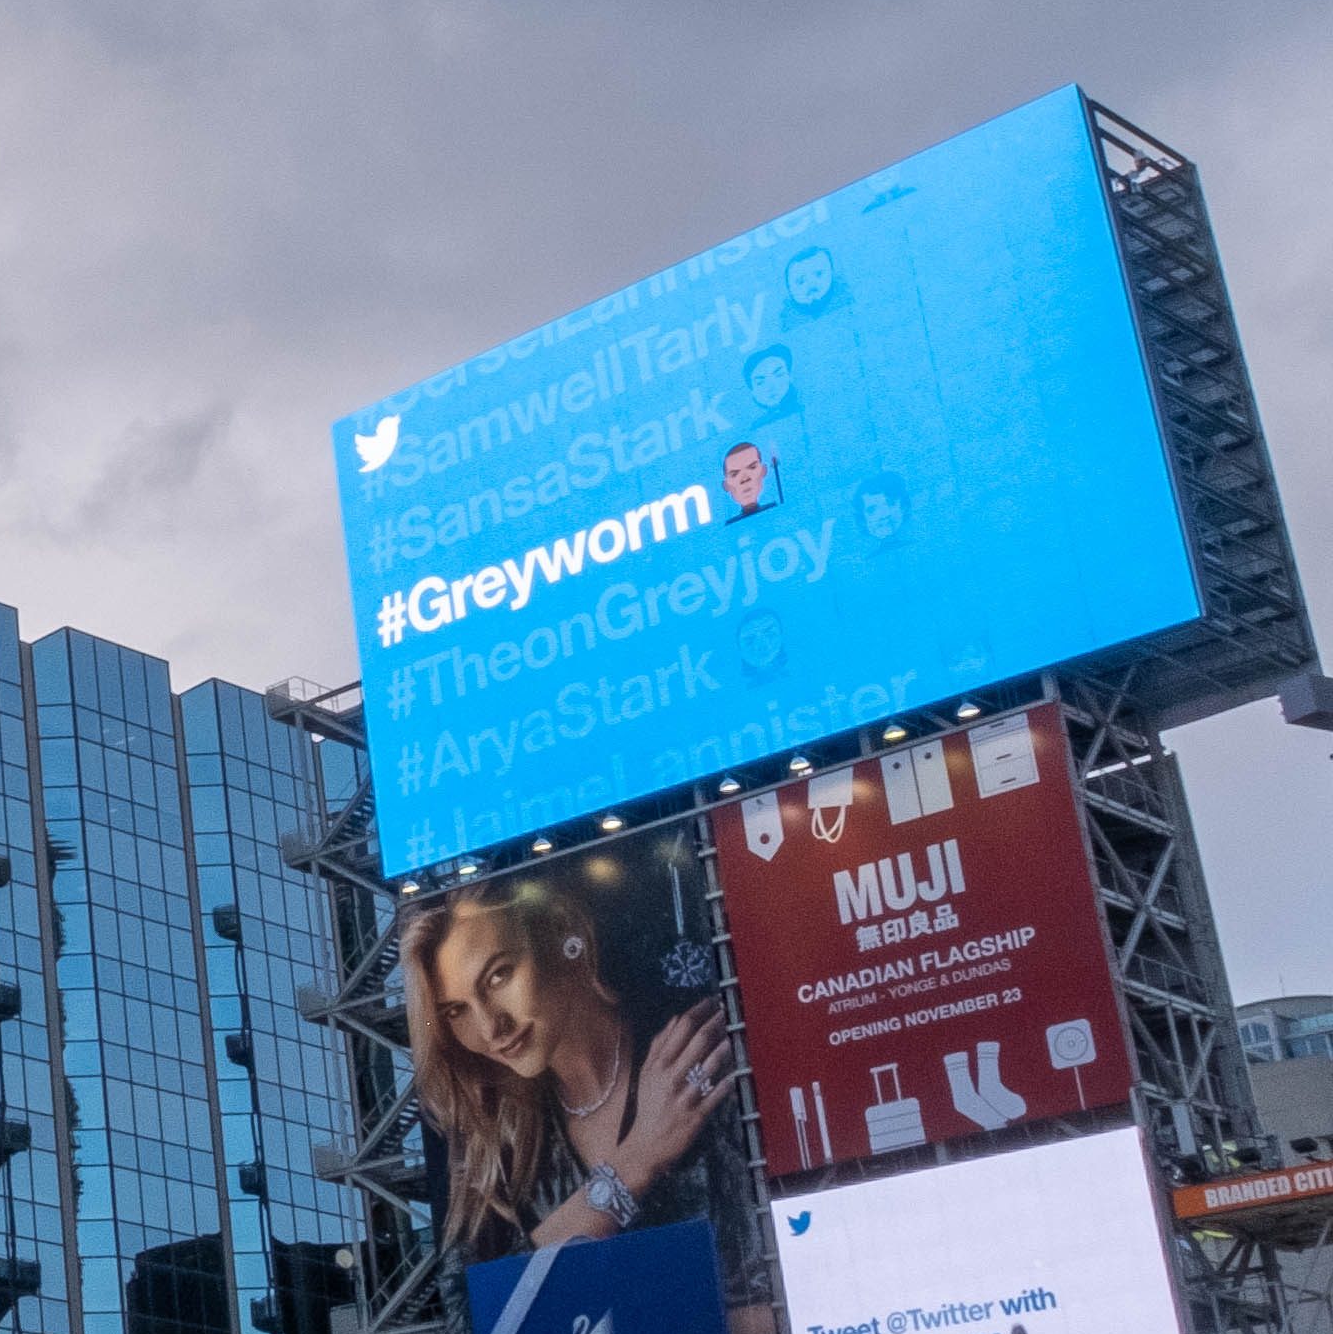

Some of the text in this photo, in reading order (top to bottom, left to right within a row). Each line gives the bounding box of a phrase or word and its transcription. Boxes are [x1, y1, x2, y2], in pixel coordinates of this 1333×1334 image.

[369, 387, 735, 575] #SansaStark
[377, 483, 712, 649] #Greyworm
[386, 518, 836, 721] #TheonGreyjoy
[397, 641, 722, 797] #AryaStark
[833, 838, 966, 925] MUJI
[797, 926, 1036, 1004] CANADIAN FLAGSHIP
[855, 903, 960, 953] 無印良品
[827, 992, 877, 1015] ATRIUM
[887, 977, 938, 1000] YONGE
[940, 974, 950, 988] &
[951, 958, 1012, 984] DUNDAS
[828, 987, 1023, 1046] OPENING NOVEMBER 23
[1204, 1174, 1293, 1209] BRANDED
[999, 1286, 1058, 1318] with
